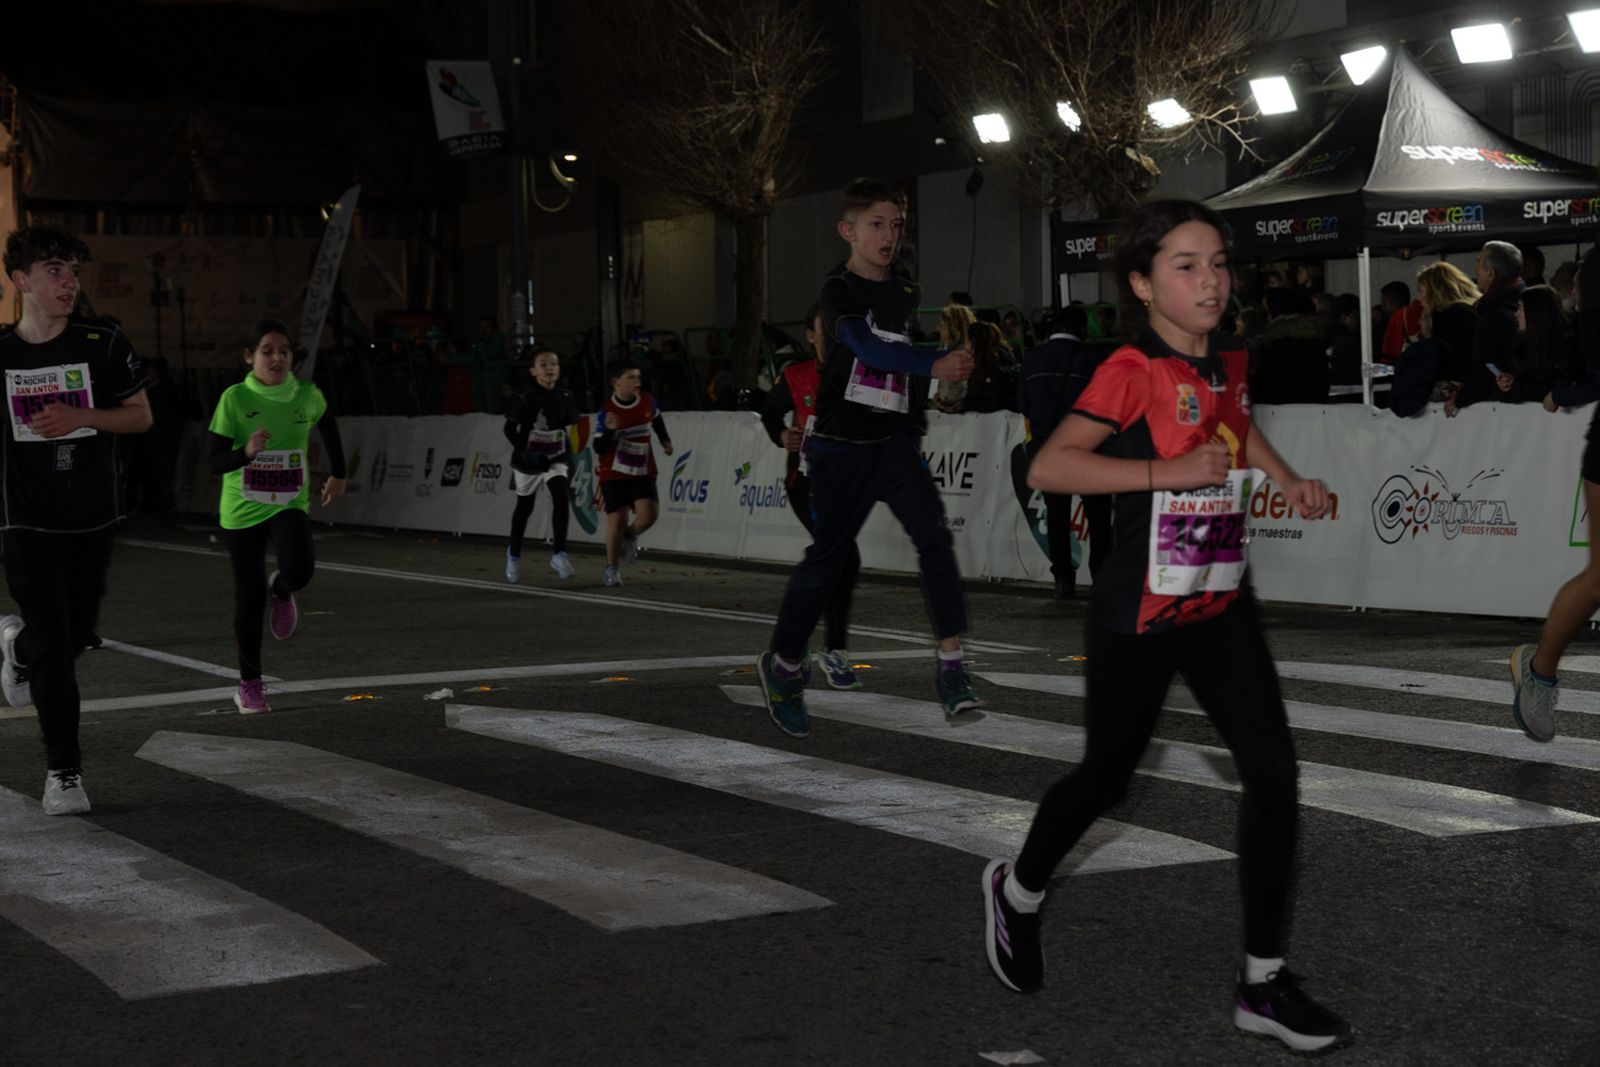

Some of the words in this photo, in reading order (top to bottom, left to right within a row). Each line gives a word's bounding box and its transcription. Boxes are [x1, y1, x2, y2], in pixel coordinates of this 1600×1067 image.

[1376, 205, 1484, 232] superscreen
[23, 376, 47, 386] NOCHE
[48, 375, 58, 384] DE
[16, 387, 31, 395] SAN
[476, 464, 502, 479] FISIO
[921, 451, 979, 489] AVE
[251, 470, 297, 487] 15564
[739, 478, 787, 515] aqualia
[1169, 501, 1196, 513] SAN
[1258, 528, 1303, 540] maestras
[1461, 526, 1485, 536] RIEGOS
[1489, 527, 1517, 537] PISCINAS
